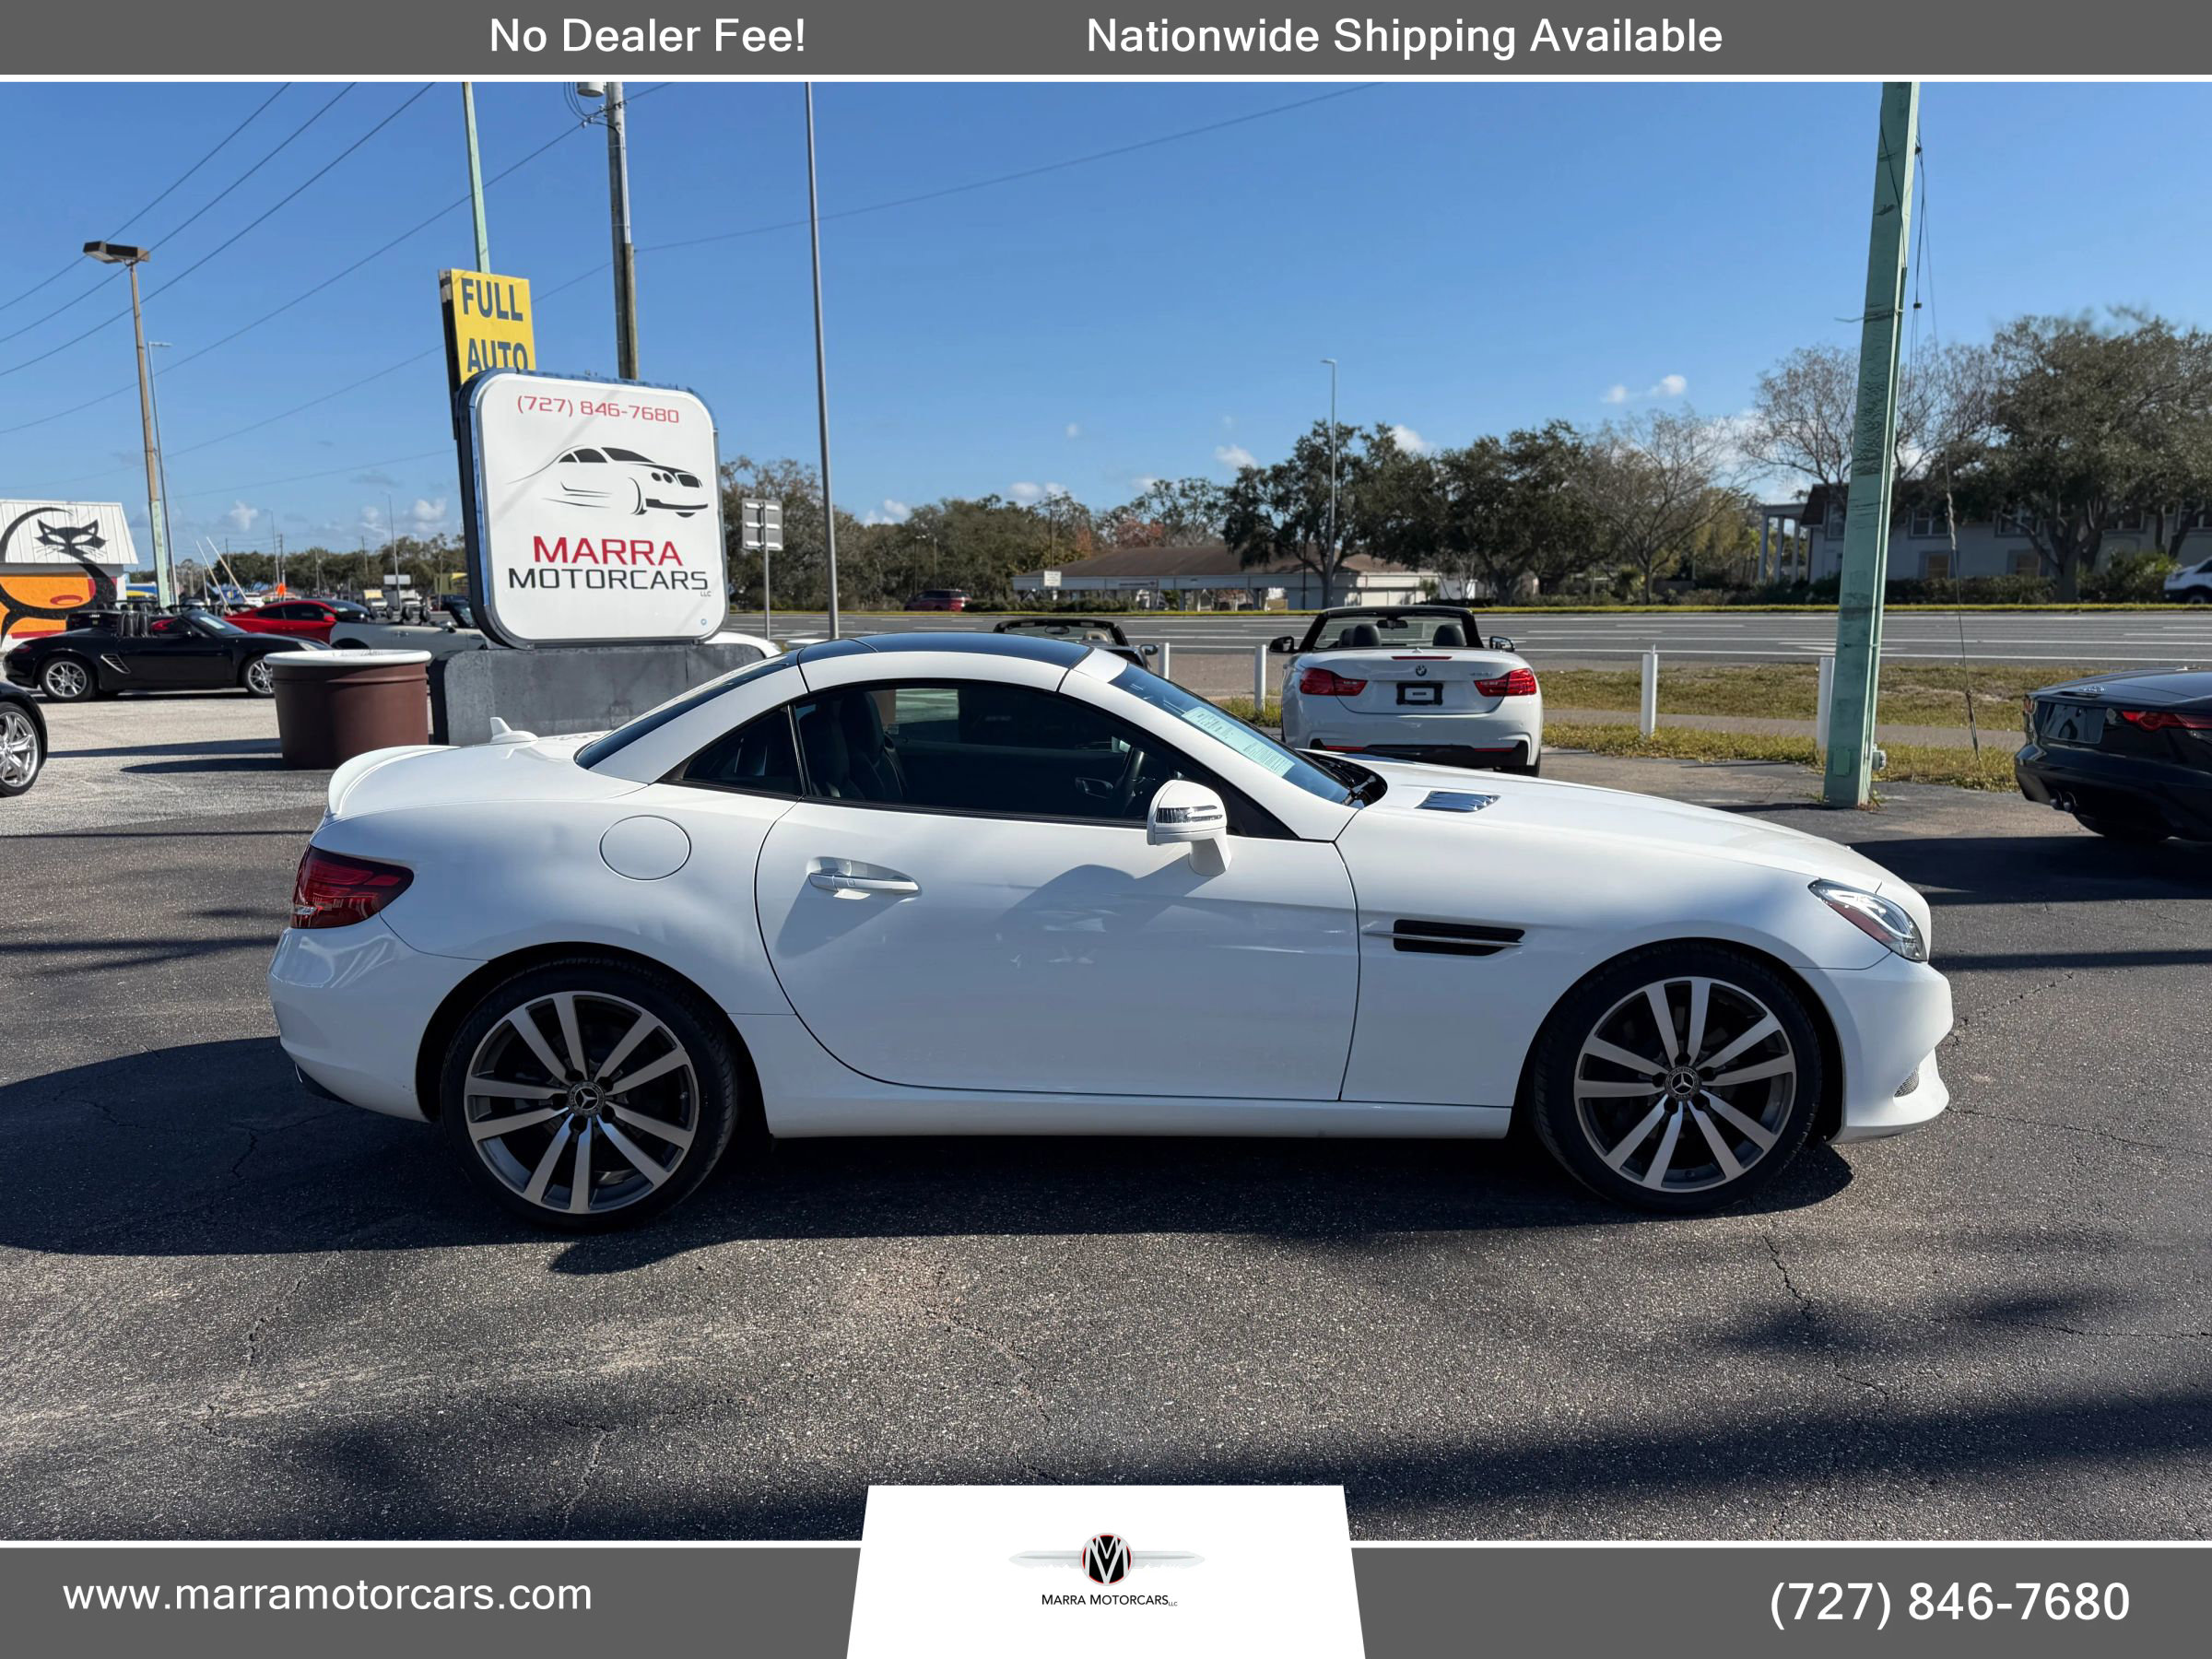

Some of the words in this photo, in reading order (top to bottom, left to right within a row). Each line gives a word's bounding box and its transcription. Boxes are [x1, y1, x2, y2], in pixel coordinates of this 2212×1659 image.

[461, 277, 524, 322] FULL
[467, 337, 529, 372] AUTO
[517, 394, 573, 418] (727)
[581, 400, 679, 424] 846-7680
[533, 535, 684, 566] MARRA
[508, 567, 709, 591] MOTORCARS
